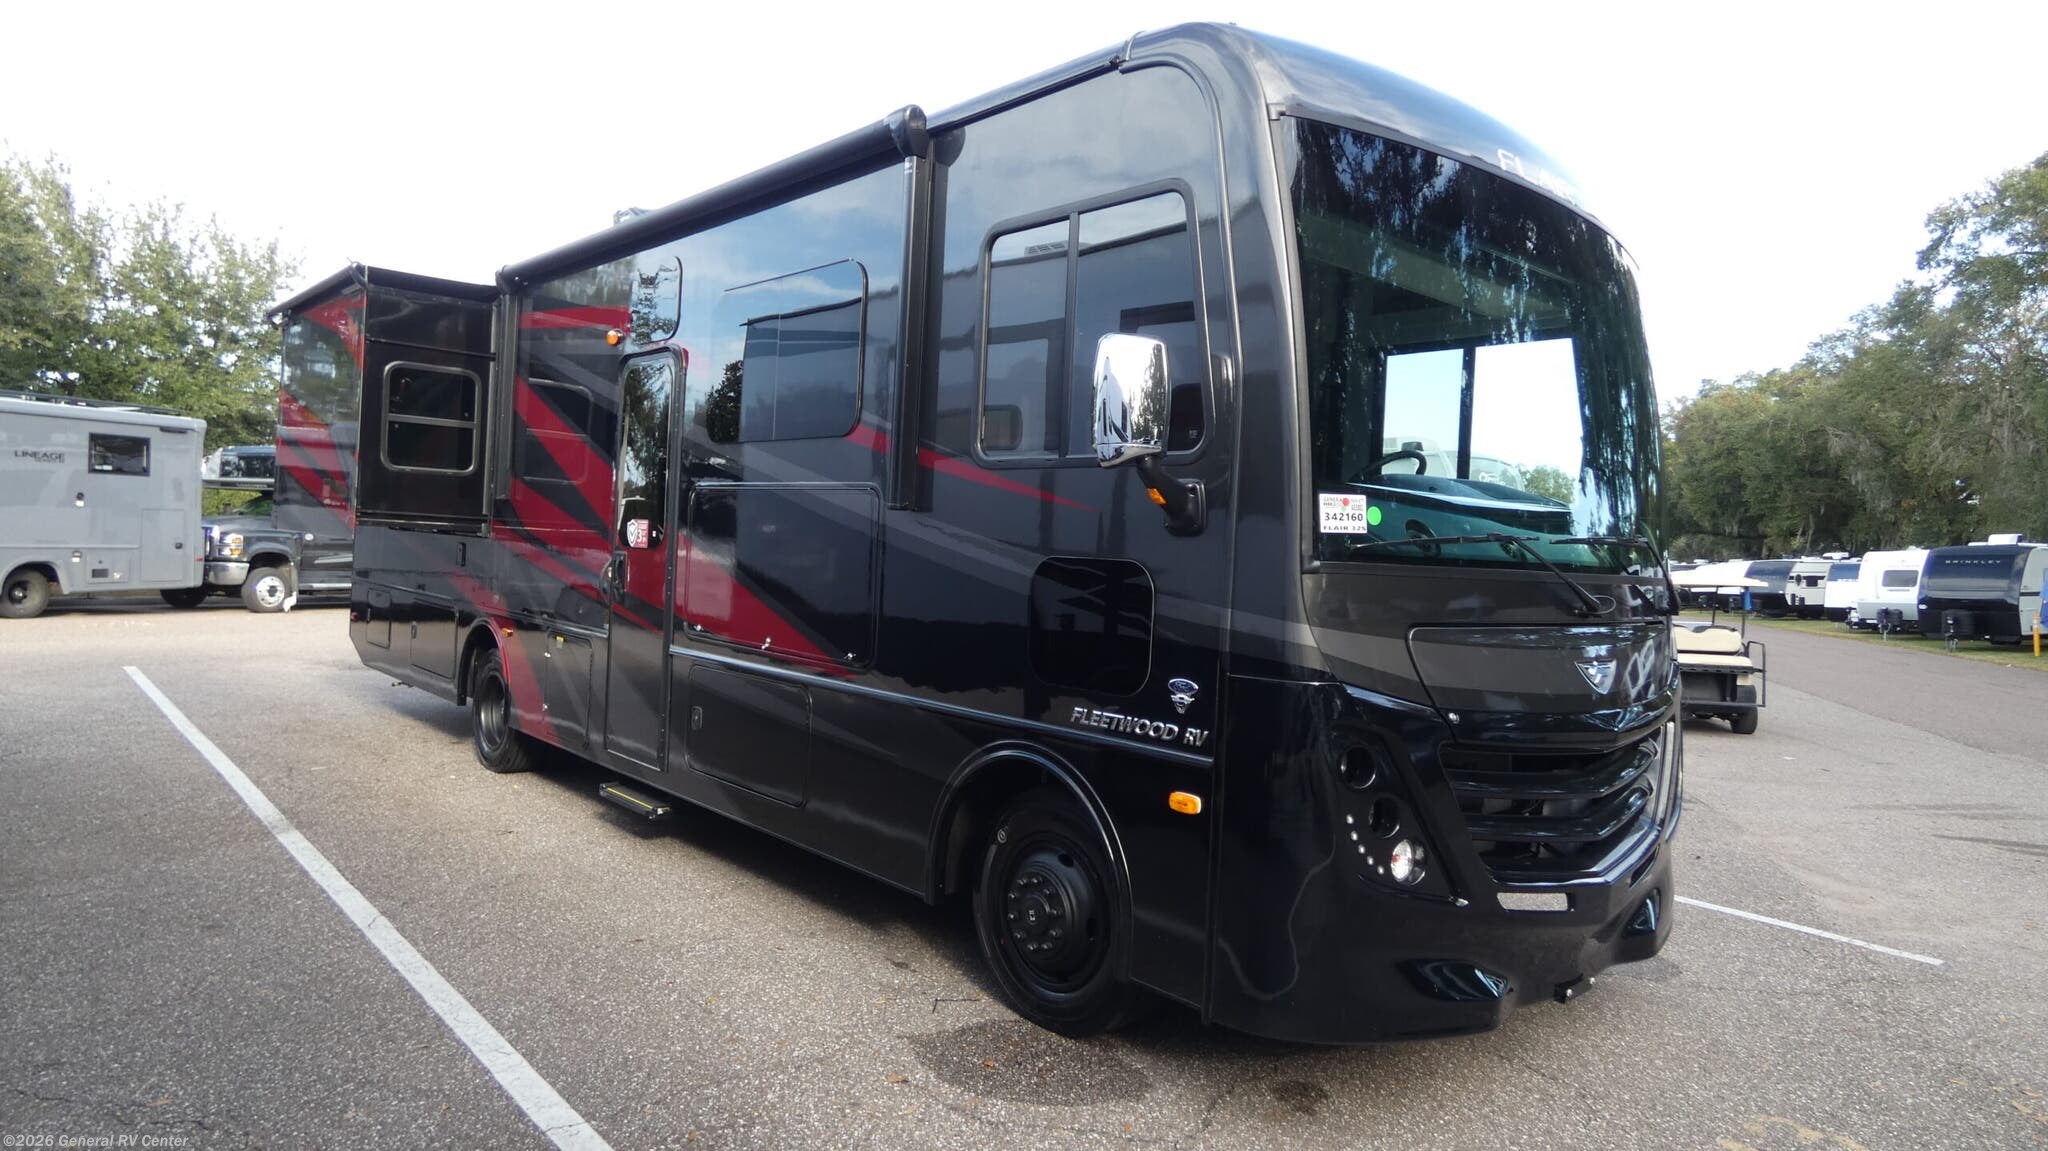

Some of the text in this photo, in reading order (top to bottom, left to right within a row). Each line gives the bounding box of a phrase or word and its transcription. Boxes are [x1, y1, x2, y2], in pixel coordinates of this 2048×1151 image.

[14, 449, 65, 461] LINEAGE
[1324, 512, 1364, 522] 342160
[1070, 707, 1209, 747] FLEETWOOD RV
